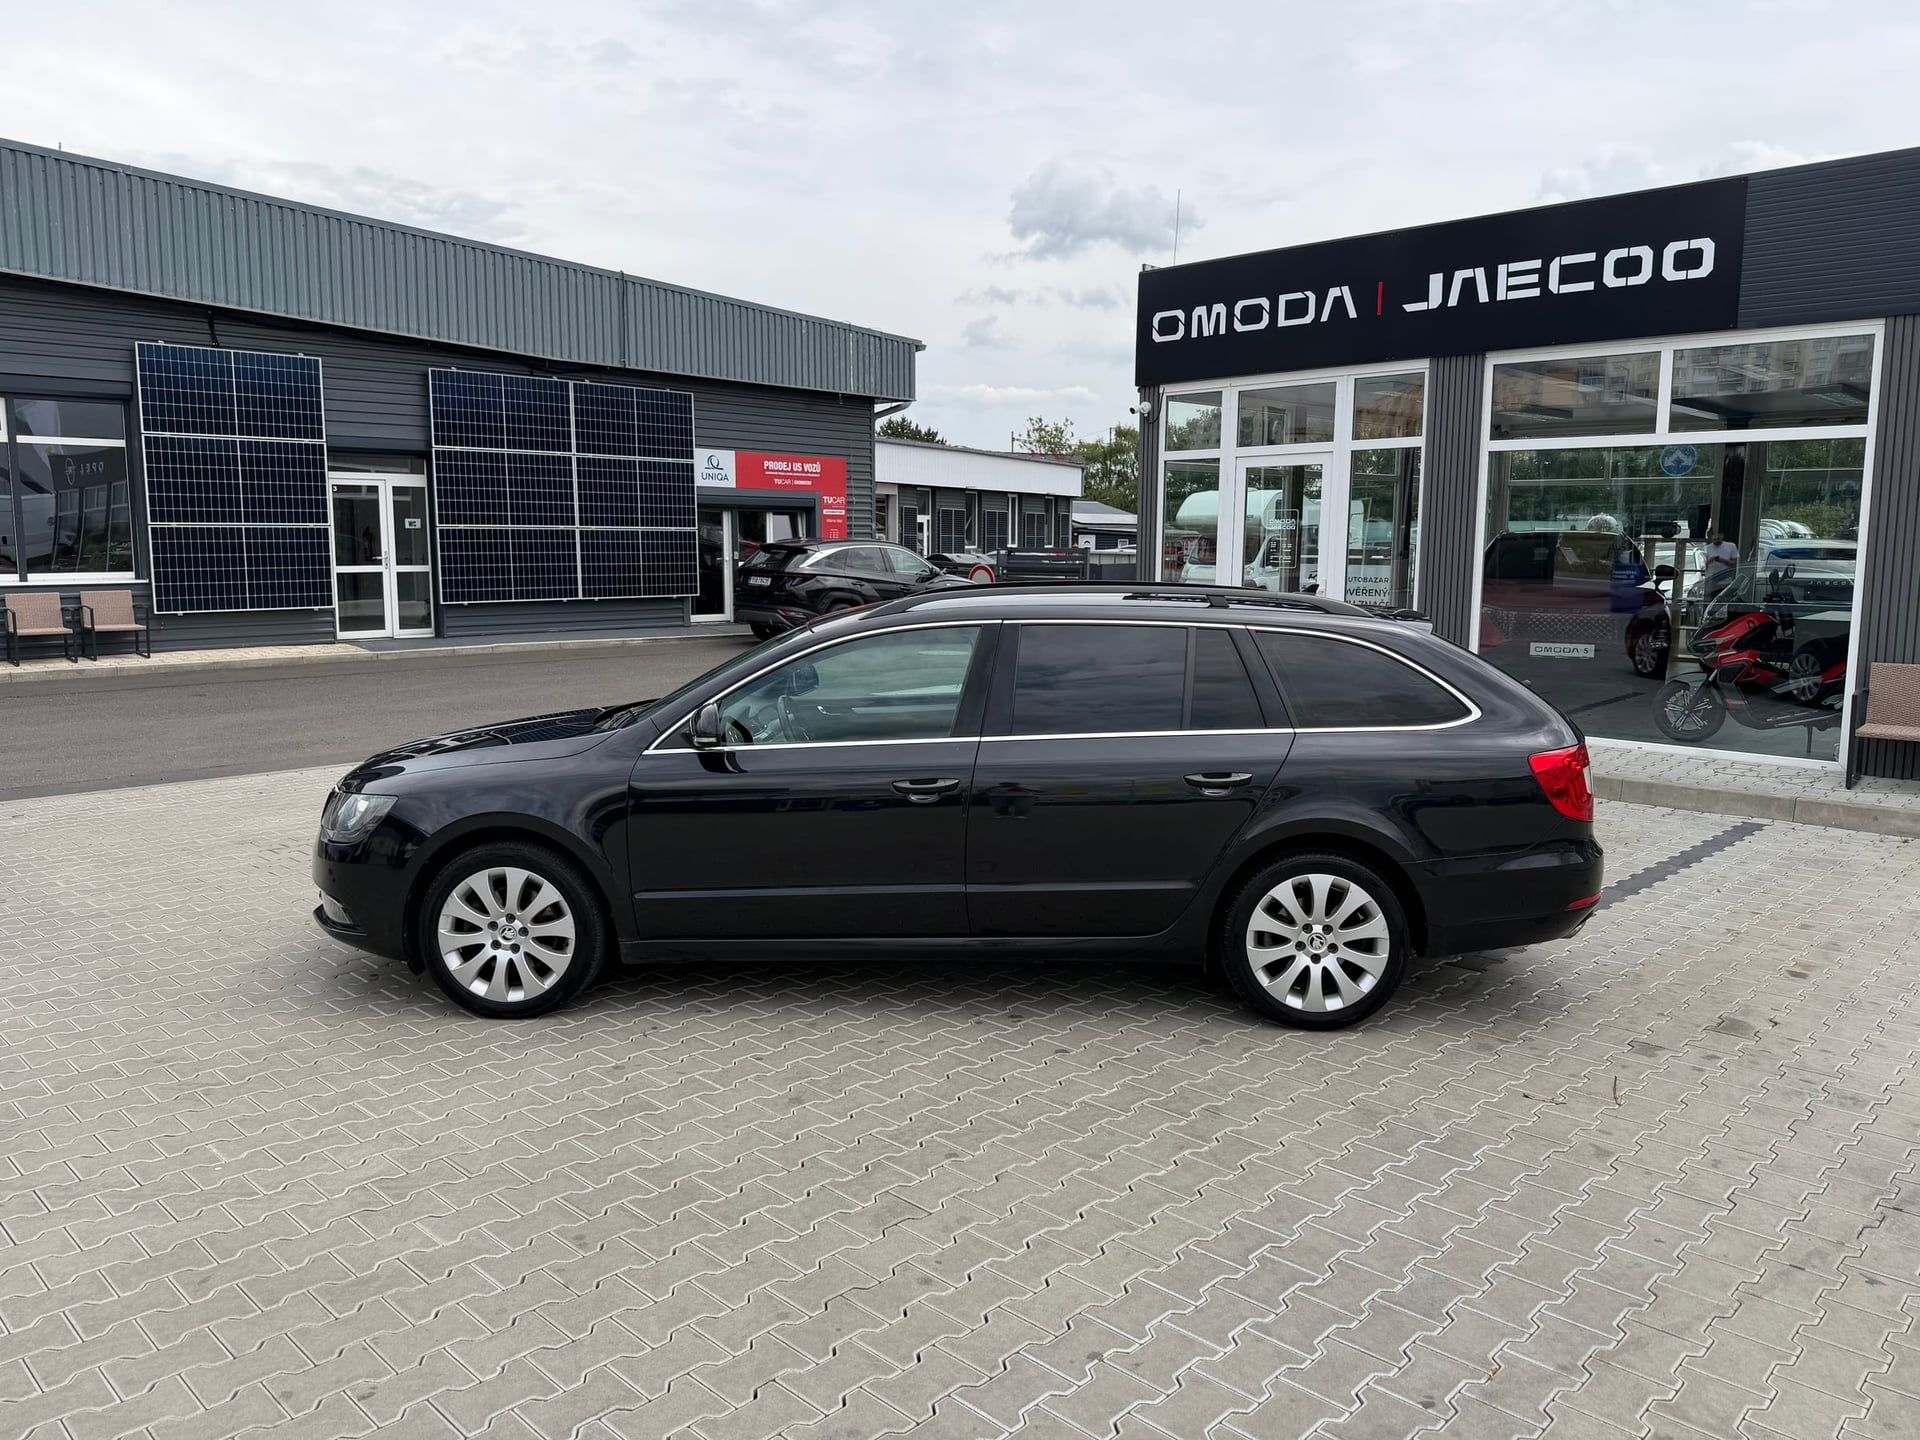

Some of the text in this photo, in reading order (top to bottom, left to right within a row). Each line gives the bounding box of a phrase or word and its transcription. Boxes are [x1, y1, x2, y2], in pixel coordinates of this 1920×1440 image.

[1152, 237, 1716, 343] OMODA JAECOO
[764, 461, 821, 473] PRODEJ US VOZŮ
[701, 472, 729, 481] UNIQA
[822, 496, 845, 504] TUCAR
[1347, 576, 1389, 584] UTOBAZAR
[1346, 586, 1390, 597] VĚŘENÝ
[1534, 646, 1579, 654] OMODA
